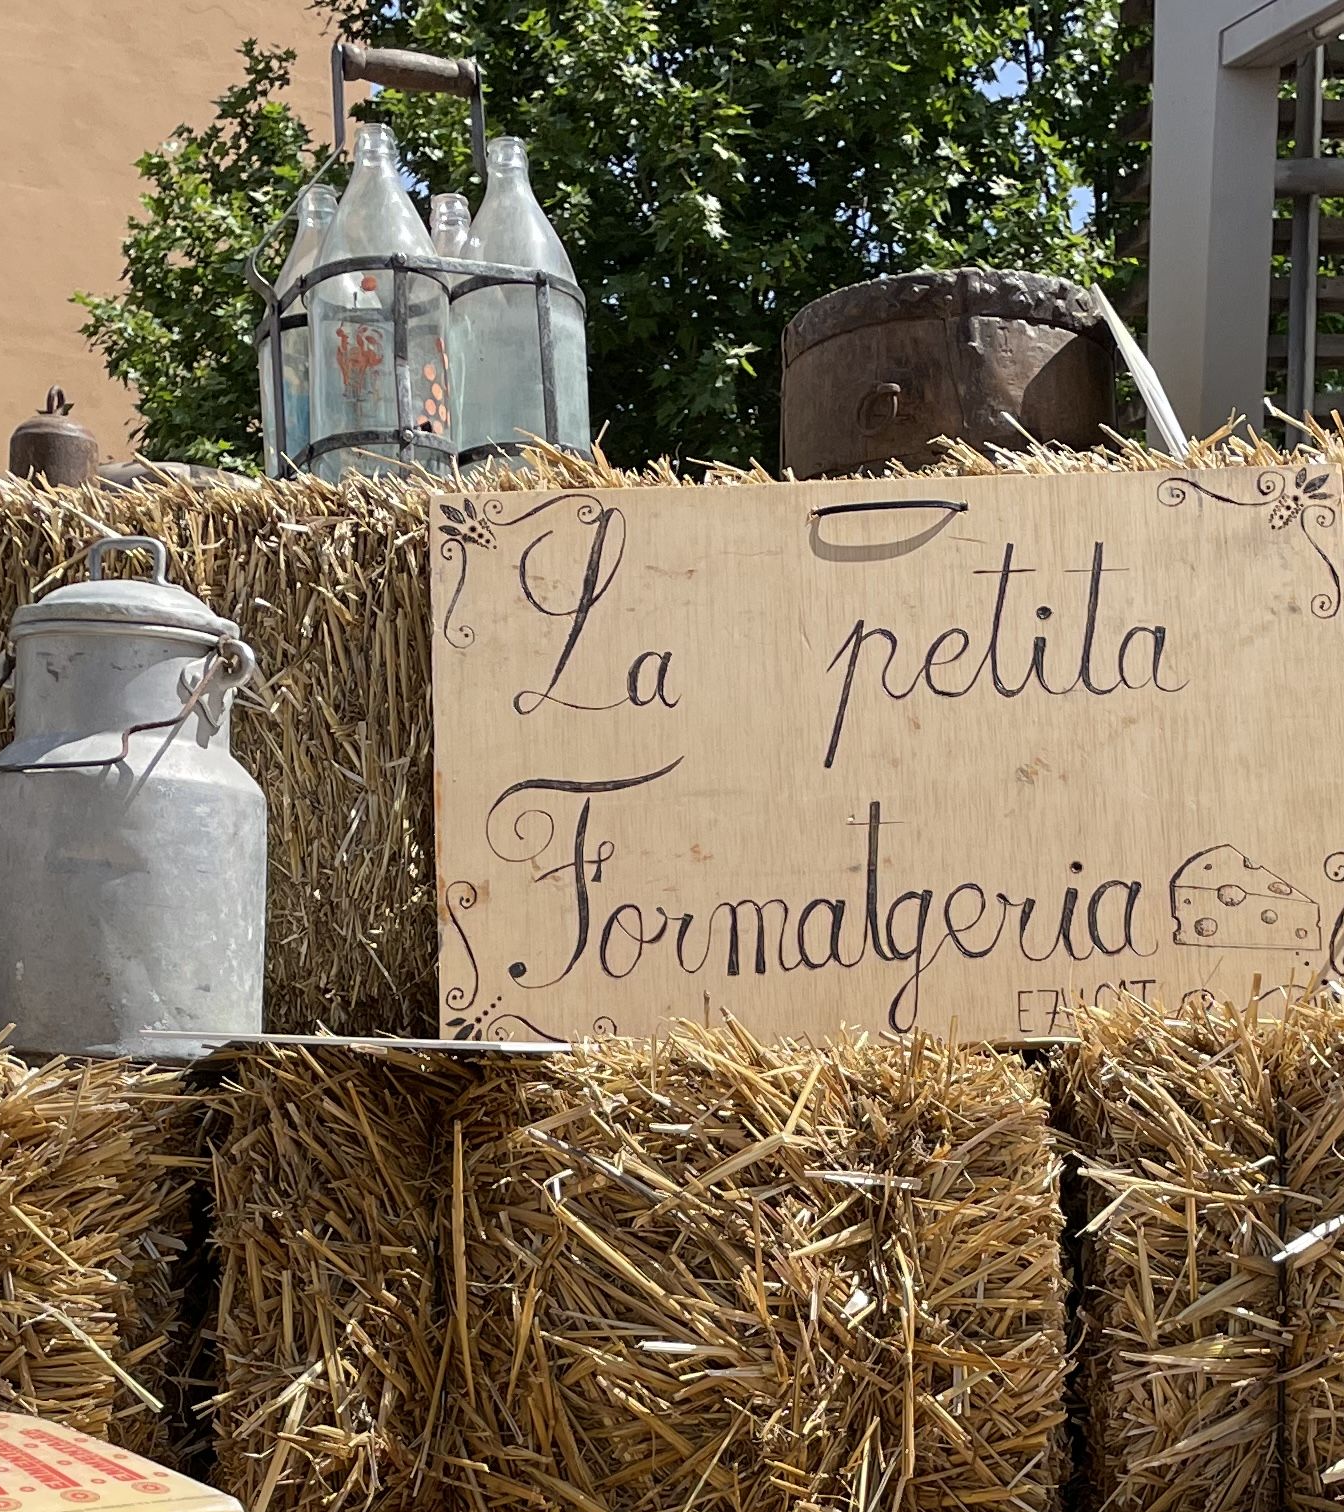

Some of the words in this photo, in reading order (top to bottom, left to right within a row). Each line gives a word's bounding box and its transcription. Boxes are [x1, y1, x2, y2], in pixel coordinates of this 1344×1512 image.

[512, 506, 683, 716] La
[824, 540, 1188, 769] petita
[486, 755, 1160, 1035] Formatgeria
